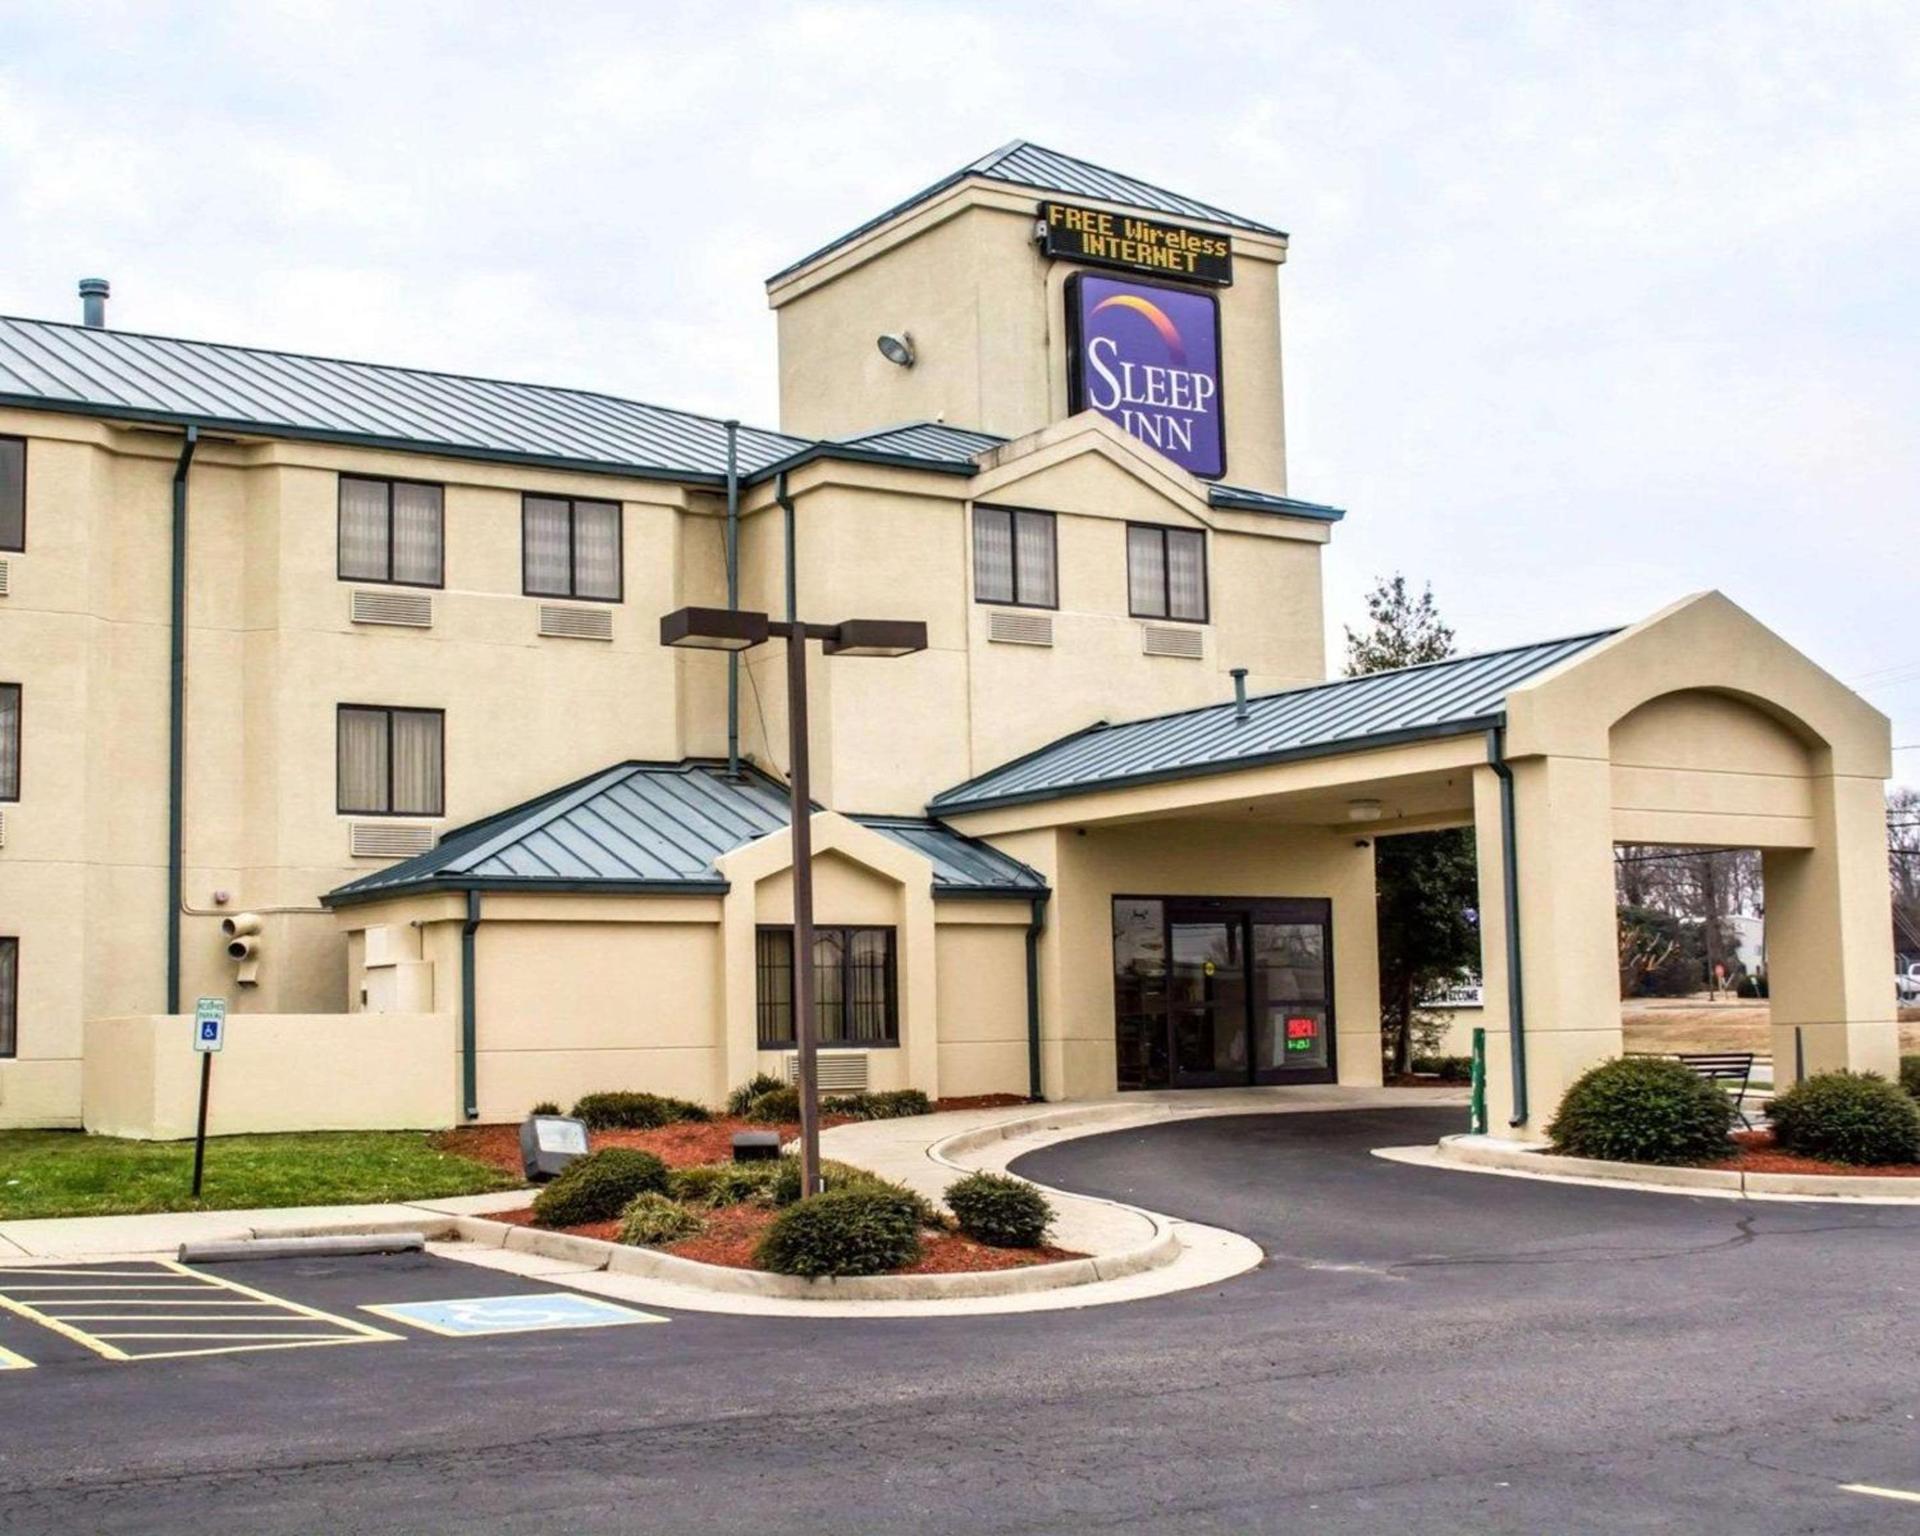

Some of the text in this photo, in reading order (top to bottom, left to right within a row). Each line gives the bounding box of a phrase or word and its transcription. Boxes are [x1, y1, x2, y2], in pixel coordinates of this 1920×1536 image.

[1050, 205, 1227, 257] FREE Wireless
[1083, 233, 1197, 272] INTERNET
[1088, 336, 1214, 412] SLEEP
[1120, 409, 1193, 452] INN
